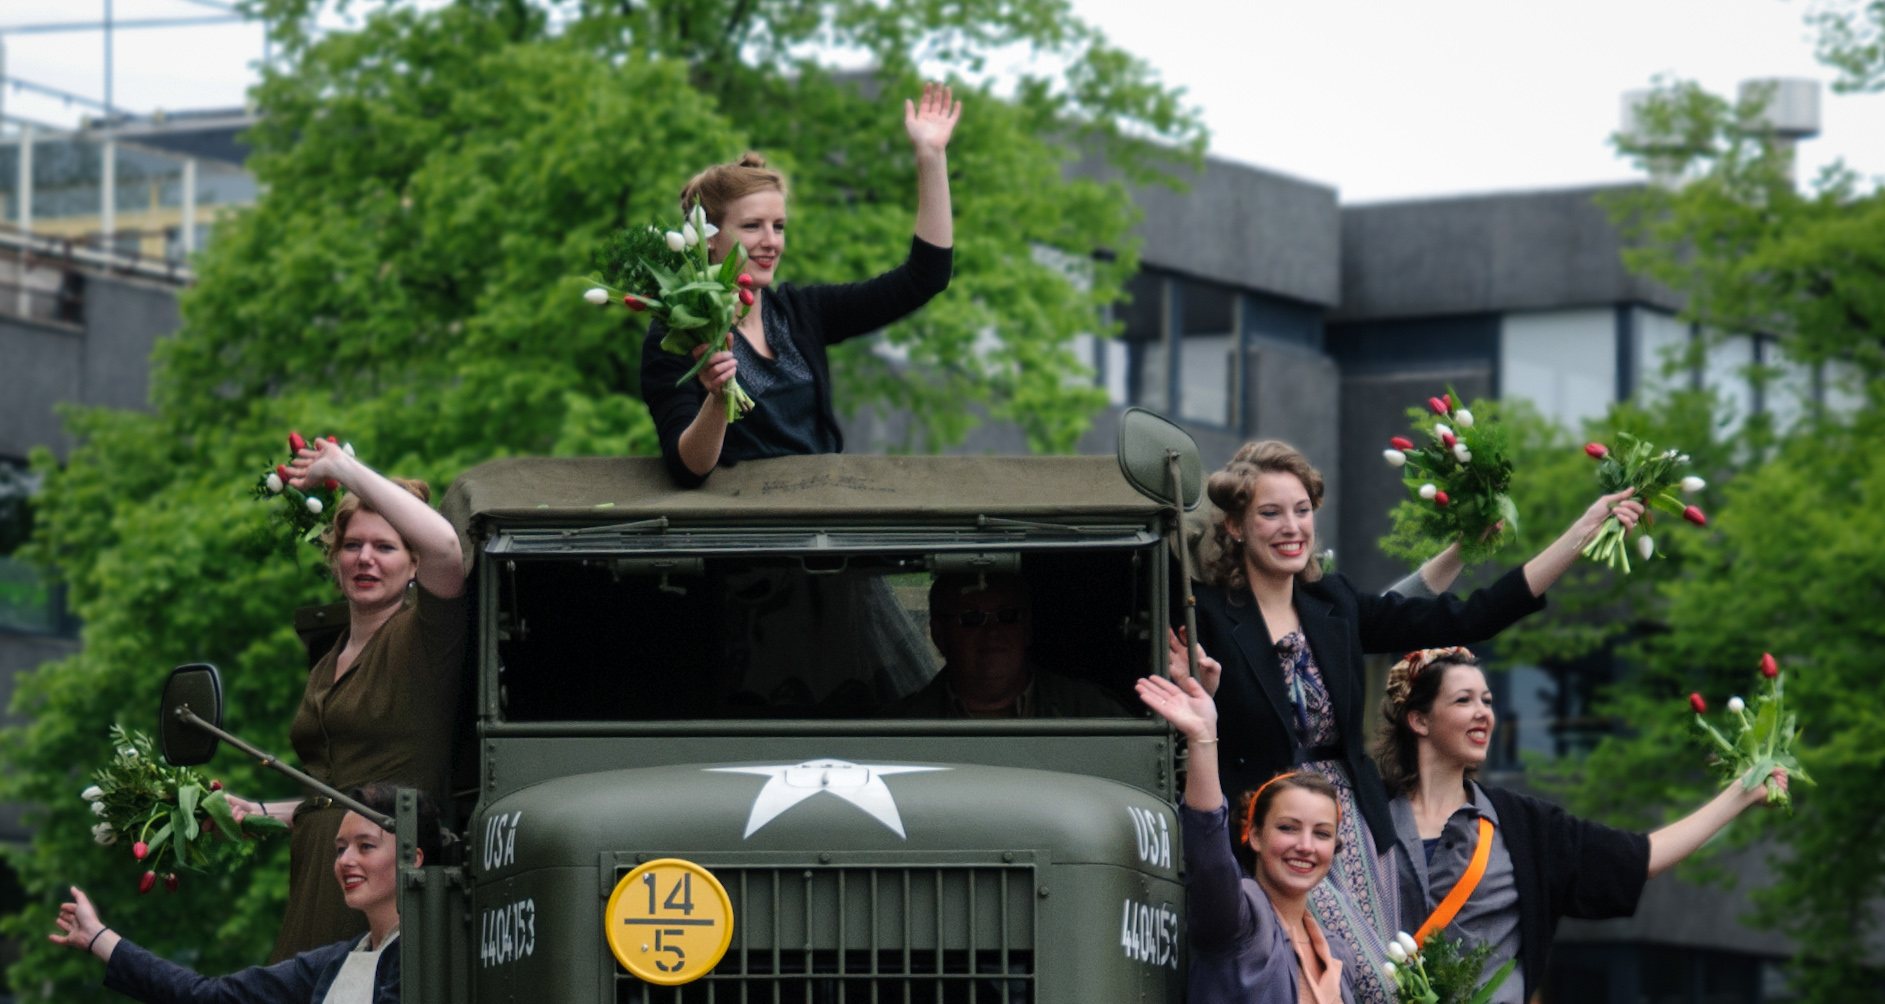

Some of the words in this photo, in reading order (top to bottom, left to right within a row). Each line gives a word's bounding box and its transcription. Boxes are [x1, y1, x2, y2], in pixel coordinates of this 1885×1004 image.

[484, 811, 522, 871] USA
[1128, 806, 1171, 869] USA
[643, 872, 694, 915] 14
[481, 898, 535, 968] 4404153
[655, 929, 685, 972] 5
[1121, 898, 1178, 970] 4404153
